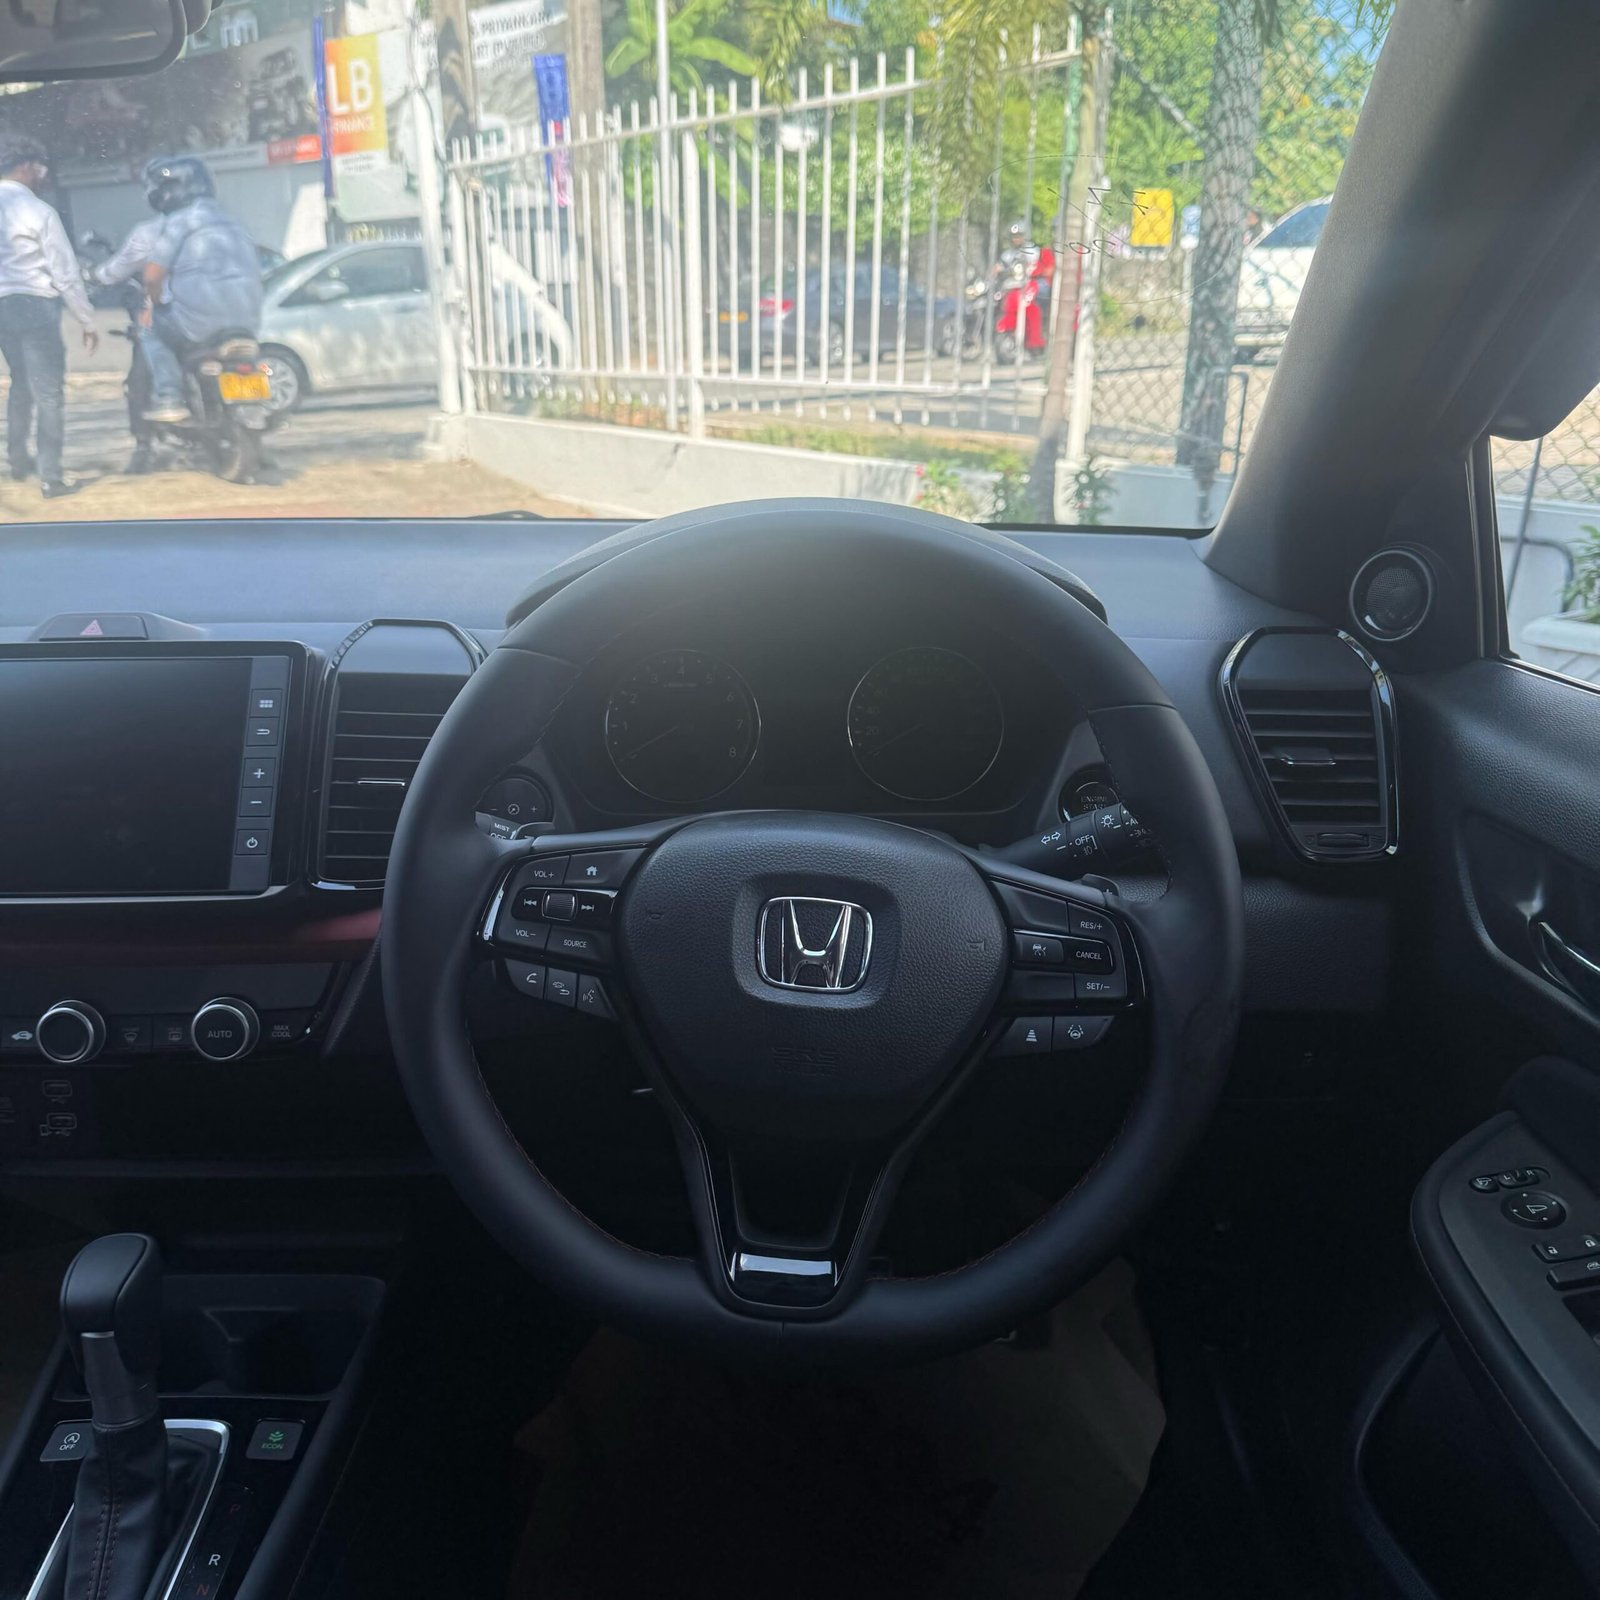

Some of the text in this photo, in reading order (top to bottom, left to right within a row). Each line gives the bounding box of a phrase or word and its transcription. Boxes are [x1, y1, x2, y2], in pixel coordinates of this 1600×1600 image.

[326, 58, 374, 115] LB
[865, 725, 880, 736] 20
[728, 747, 737, 758] 8
[494, 822, 510, 832] MIST
[1074, 834, 1091, 847] OFF
[1080, 920, 1104, 931] RES/+
[563, 938, 588, 949] SOURCE
[1075, 950, 1103, 961] CANCEL
[273, 1024, 290, 1032] MAX
[207, 1029, 233, 1039] AUTO
[271, 1031, 292, 1039] COOL
[59, 1443, 76, 1451] OFF
[261, 1442, 284, 1450] ECON
[208, 1553, 221, 1566] R
[195, 1583, 211, 1597] N
